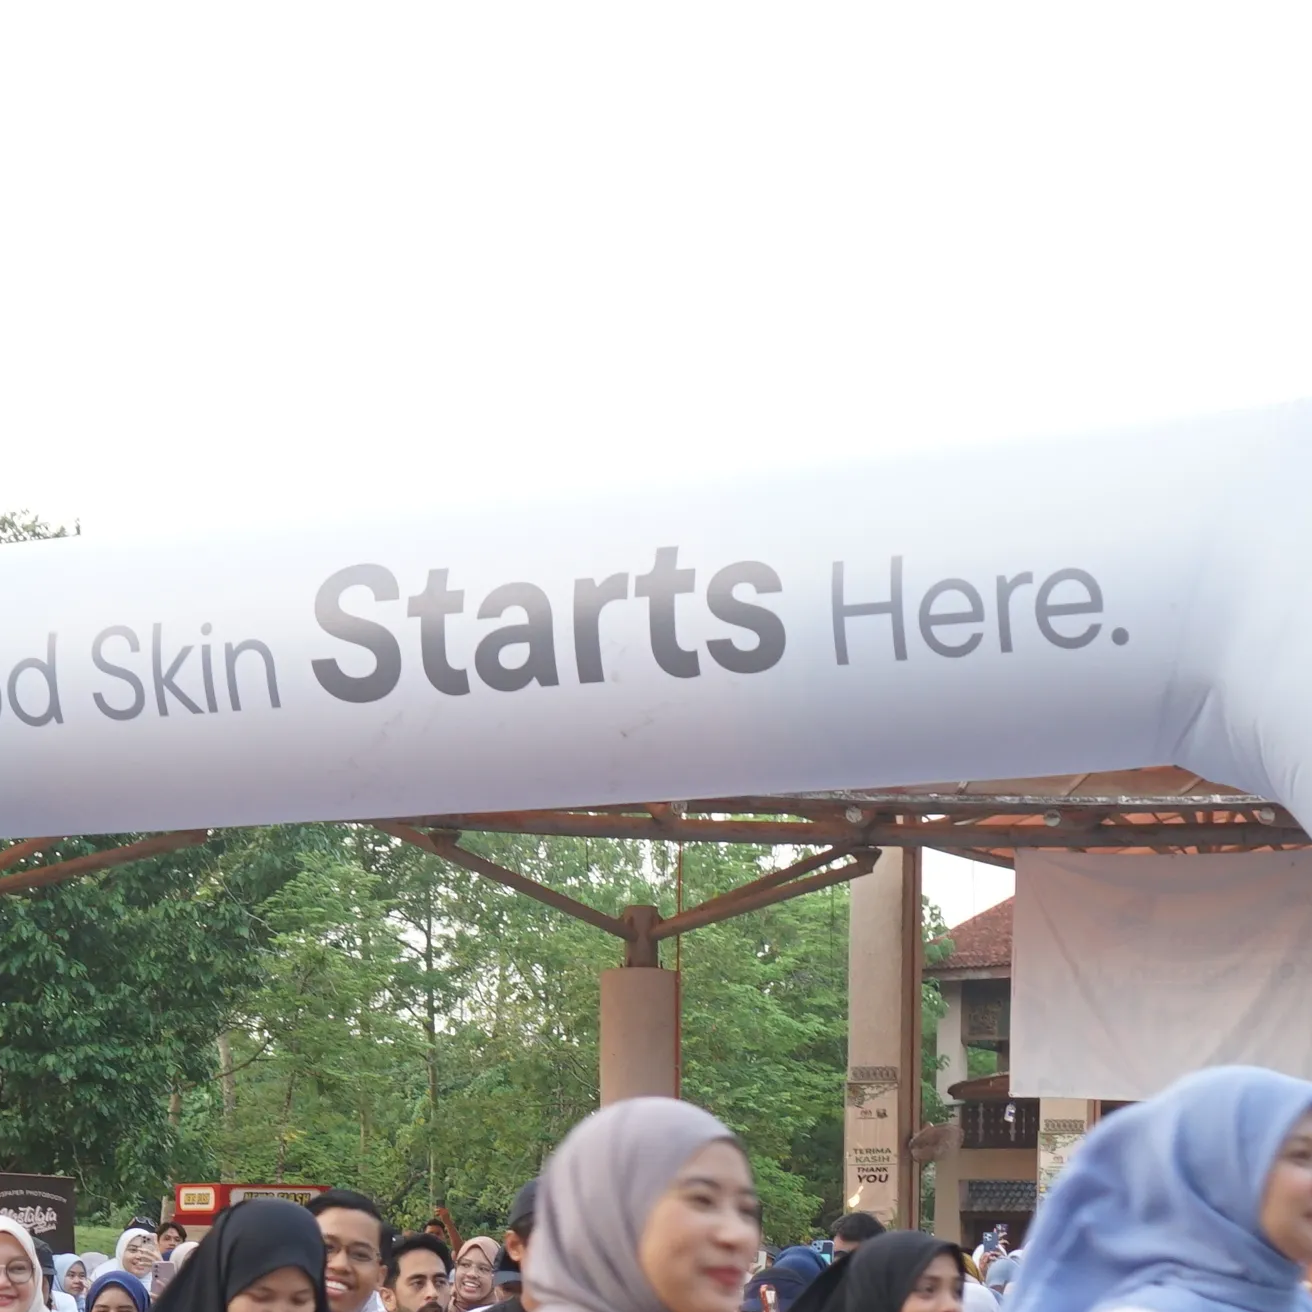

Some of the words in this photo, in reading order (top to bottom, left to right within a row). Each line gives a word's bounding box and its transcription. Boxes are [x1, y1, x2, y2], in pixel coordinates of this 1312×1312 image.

[90, 622, 281, 721] Skin
[311, 546, 787, 704] Starts
[830, 555, 1130, 667] Here.
[852, 1147, 892, 1155] TERIMA
[855, 1155, 890, 1163] KASIH
[857, 1174, 889, 1184] YOU
